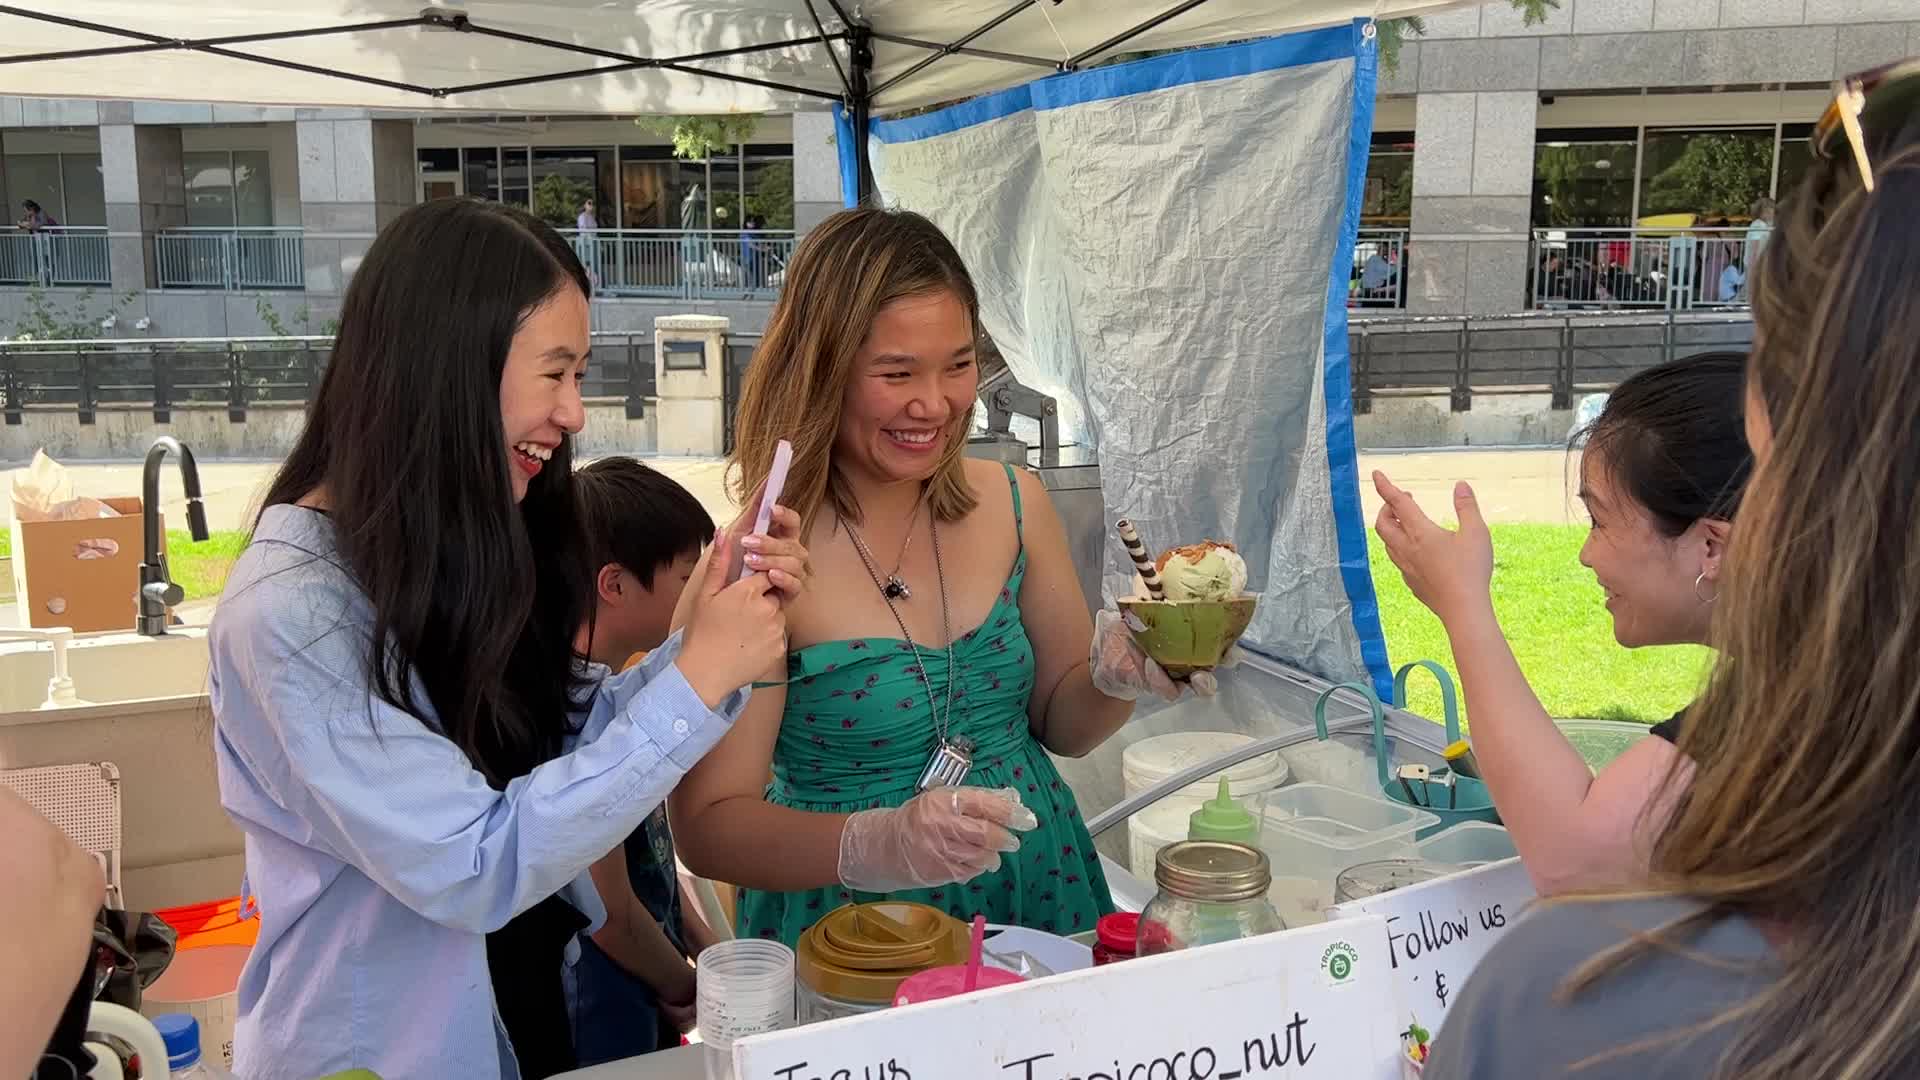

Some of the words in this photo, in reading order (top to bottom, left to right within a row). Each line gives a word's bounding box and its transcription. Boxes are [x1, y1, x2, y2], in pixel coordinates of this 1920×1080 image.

[1320, 941, 1359, 970] TROPICOCO
[1387, 909, 1469, 969] Follow
[1479, 903, 1506, 931] us
